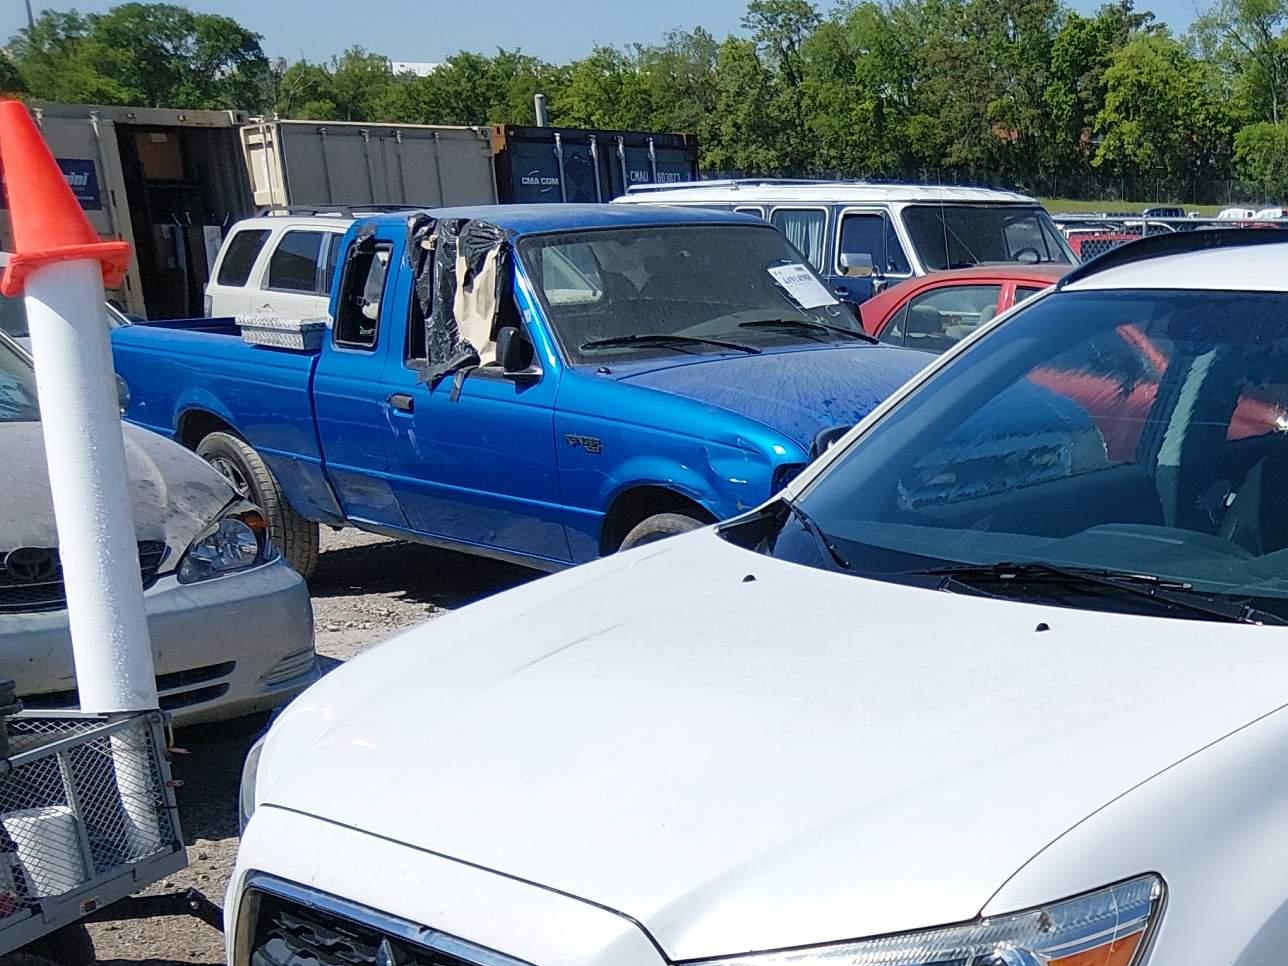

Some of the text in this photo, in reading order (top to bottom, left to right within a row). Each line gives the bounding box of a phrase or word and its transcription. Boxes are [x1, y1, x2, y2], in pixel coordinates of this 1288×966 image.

[521, 177, 559, 185] CMA CGM
[630, 170, 649, 183] CMAU
